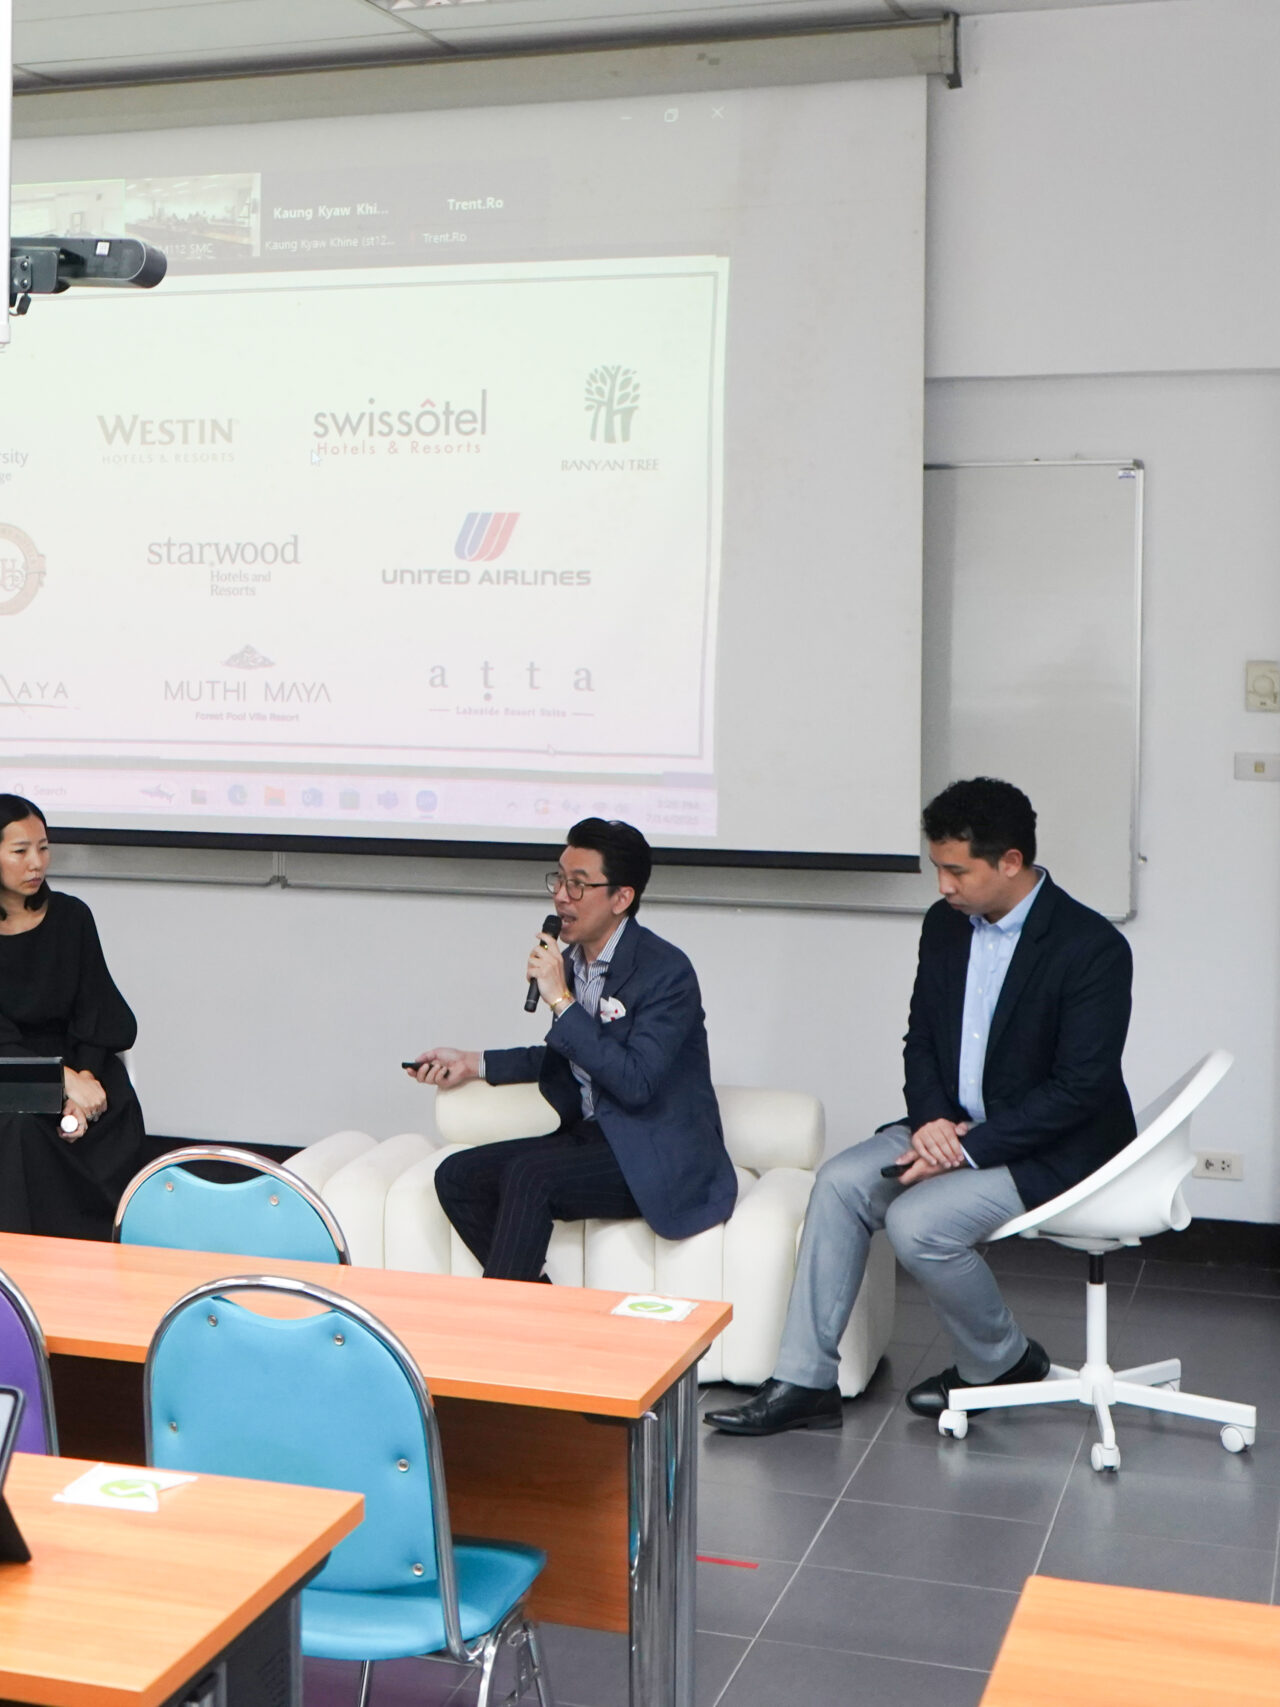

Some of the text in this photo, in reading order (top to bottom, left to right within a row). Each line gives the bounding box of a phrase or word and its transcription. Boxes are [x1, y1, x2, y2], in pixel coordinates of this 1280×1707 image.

[447, 197, 504, 211] Trent.Ro
[273, 207, 313, 221] Kaung
[318, 204, 351, 219] Kyaw
[313, 389, 487, 438] swissôtel
[317, 440, 481, 455] Hotels & Resorts
[628, 458, 660, 471] TREE
[210, 570, 272, 583] Hotels and
[381, 568, 592, 586] UNITED AIRLINES
[210, 584, 256, 596] Resorts
[164, 679, 333, 704] MUTHI MAYA
